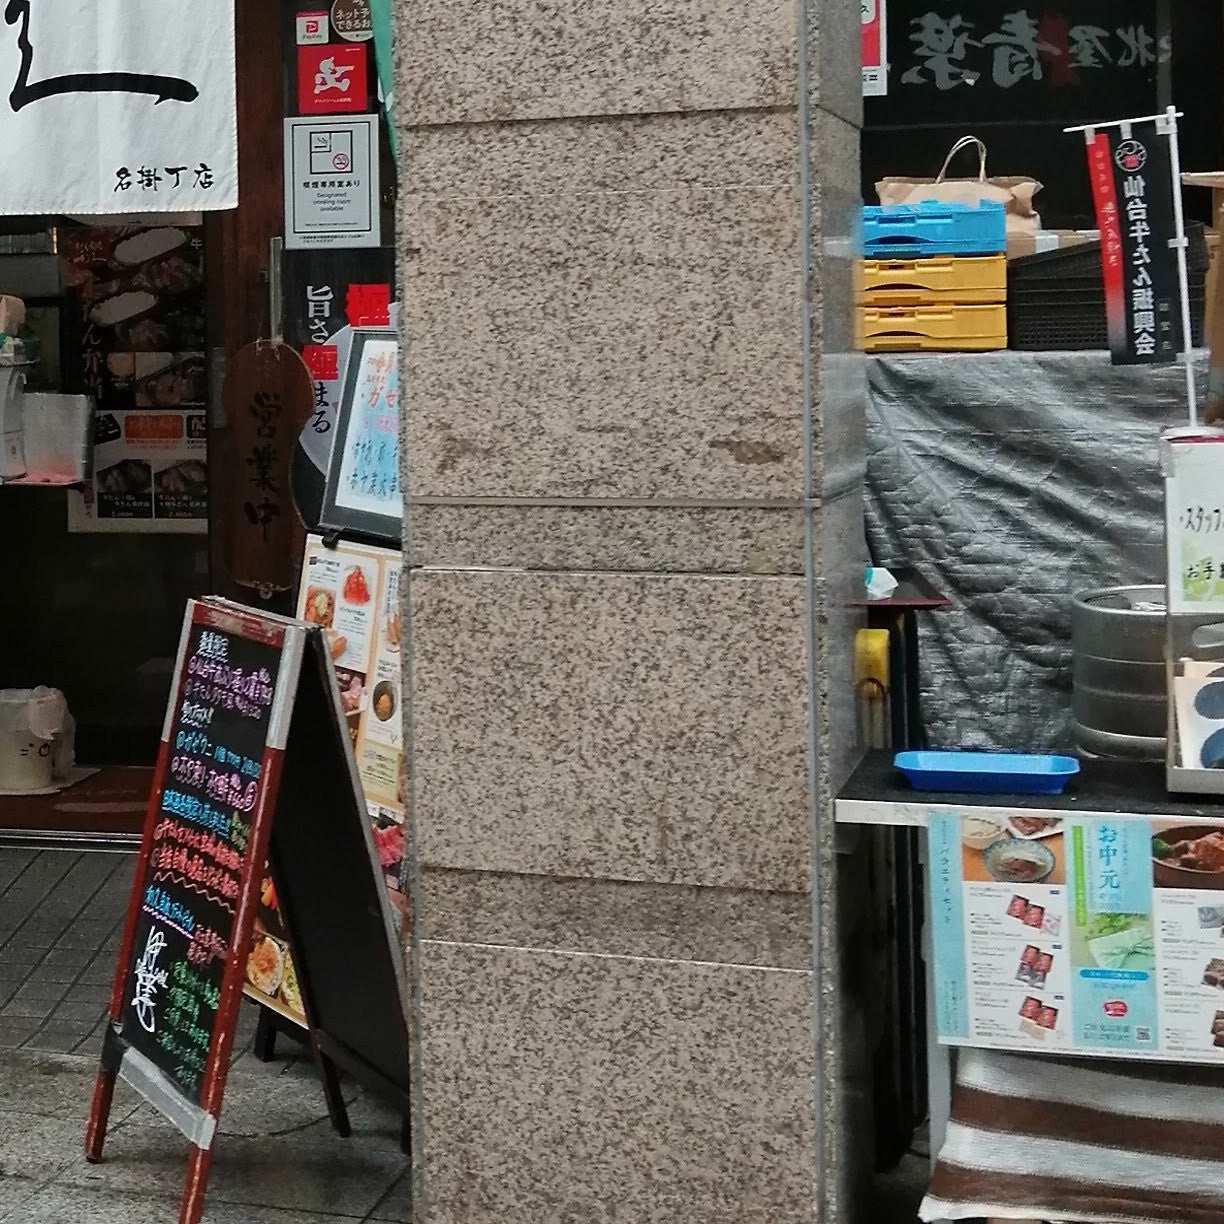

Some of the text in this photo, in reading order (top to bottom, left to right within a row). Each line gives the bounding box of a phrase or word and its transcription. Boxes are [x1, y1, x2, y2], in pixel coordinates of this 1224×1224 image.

[112, 162, 216, 193] 名掛丁店
[1098, 825, 1121, 890] お中元
